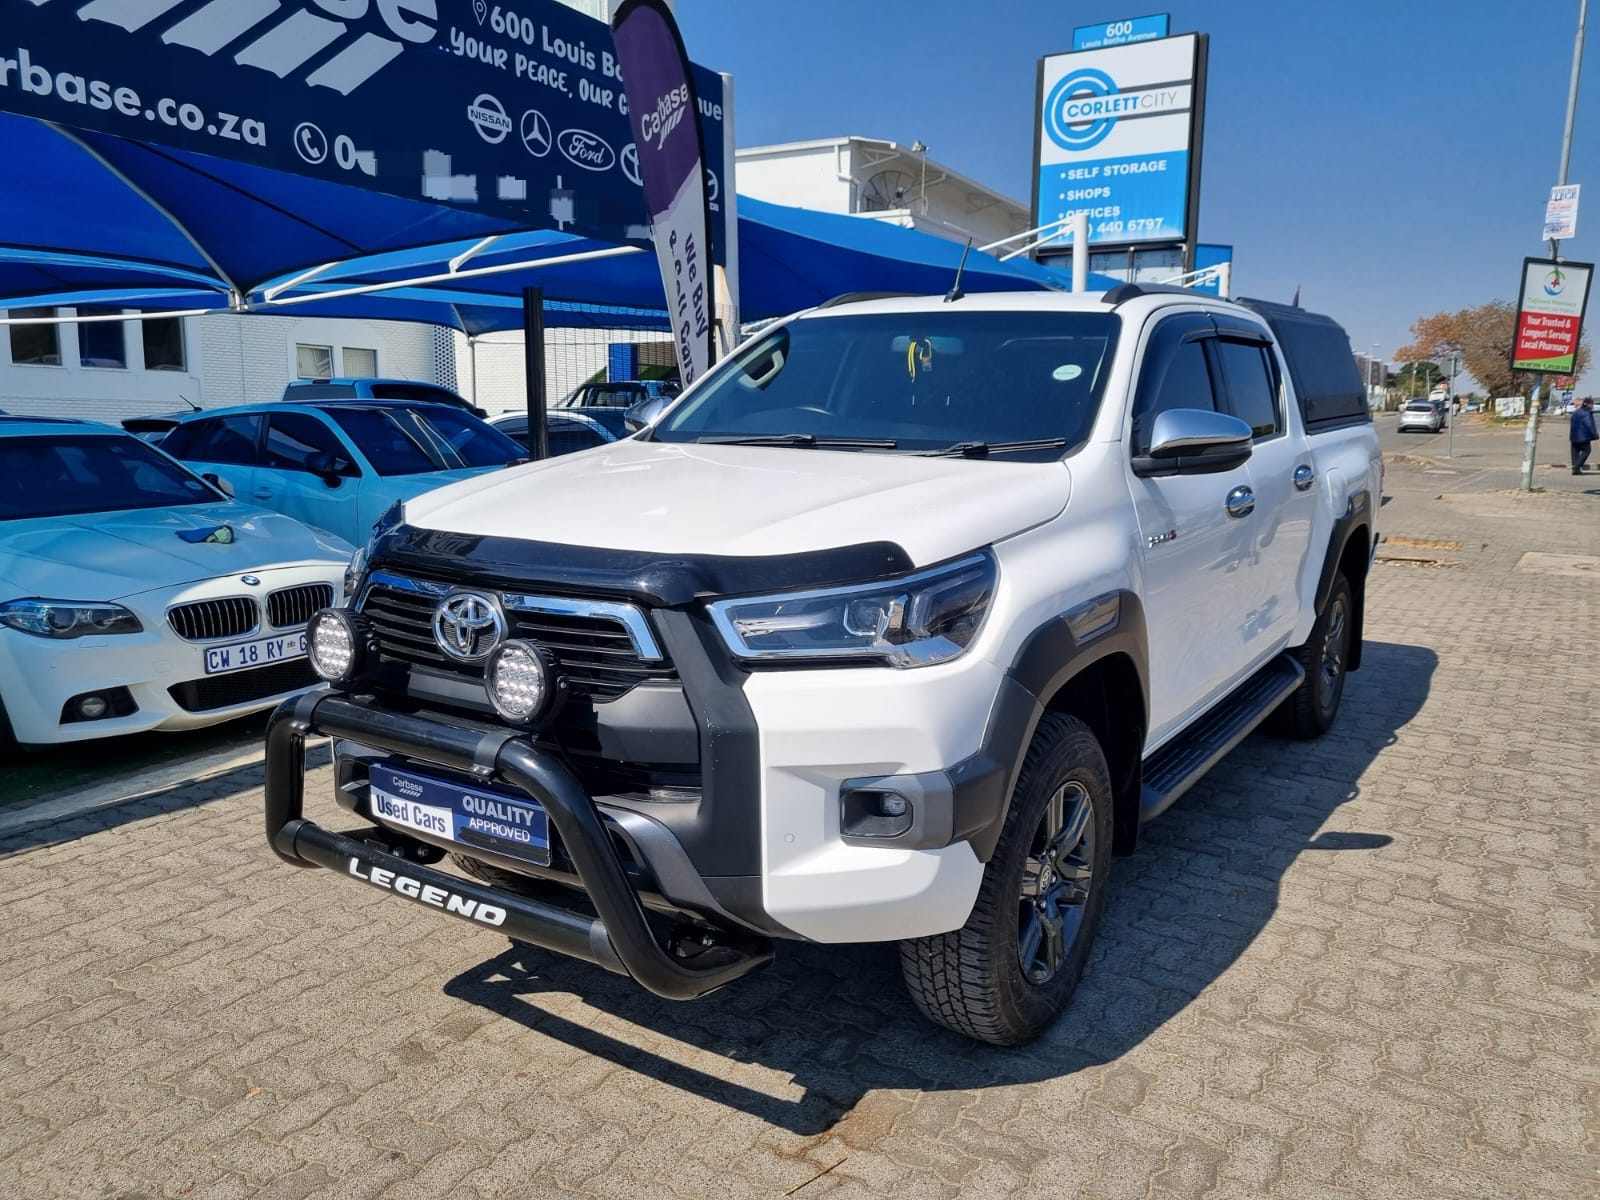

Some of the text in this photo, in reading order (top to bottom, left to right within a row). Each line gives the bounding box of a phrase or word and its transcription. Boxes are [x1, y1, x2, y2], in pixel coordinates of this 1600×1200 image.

[490, 6, 535, 45] 600
[542, 25, 596, 70] Louis
[1106, 21, 1132, 37] 600
[579, 78, 612, 109] OUR
[470, 108, 510, 129] NISSAN
[569, 134, 605, 164] Ford
[1067, 160, 1167, 180] SELF STORAGE
[1067, 187, 1111, 201] SHOPS
[1097, 221, 1123, 233] 440
[1127, 217, 1164, 232] 6797
[685, 232, 708, 338] We Buy
[681, 320, 695, 386] Cars
[209, 650, 230, 669] CW
[239, 645, 258, 665] 18
[267, 640, 284, 659] RY
[392, 776, 424, 793] Carbase
[377, 793, 446, 833] Used Cars
[462, 795, 534, 826] QUALITY
[469, 817, 530, 843] APPROVED
[349, 857, 507, 927] LEGEND
